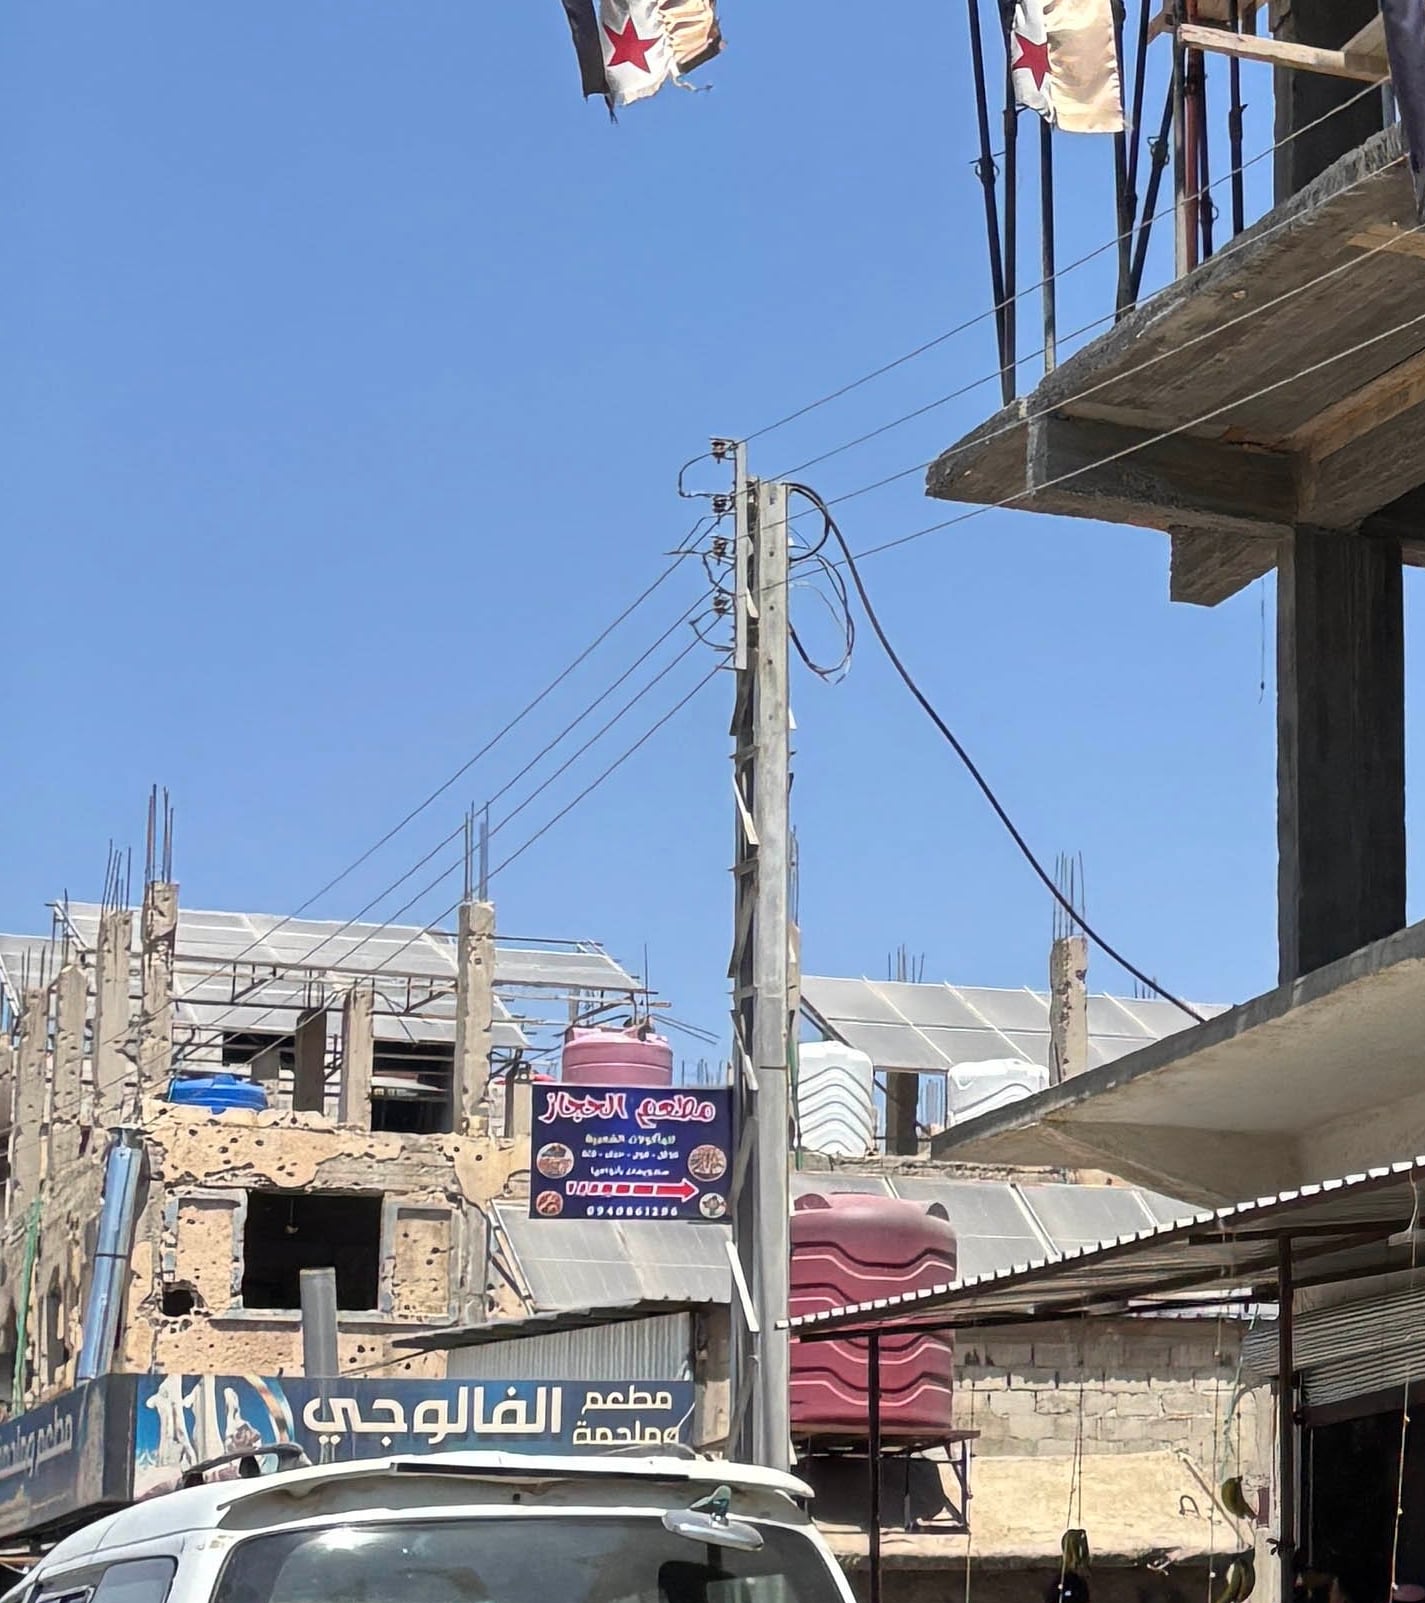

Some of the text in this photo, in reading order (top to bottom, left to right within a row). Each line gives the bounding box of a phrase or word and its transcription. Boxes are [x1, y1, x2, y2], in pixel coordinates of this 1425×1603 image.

[538, 1092, 716, 1129] مطعم الحجاز
[302, 1385, 562, 1447] الفالوجي
[581, 1384, 673, 1415] مطعم
